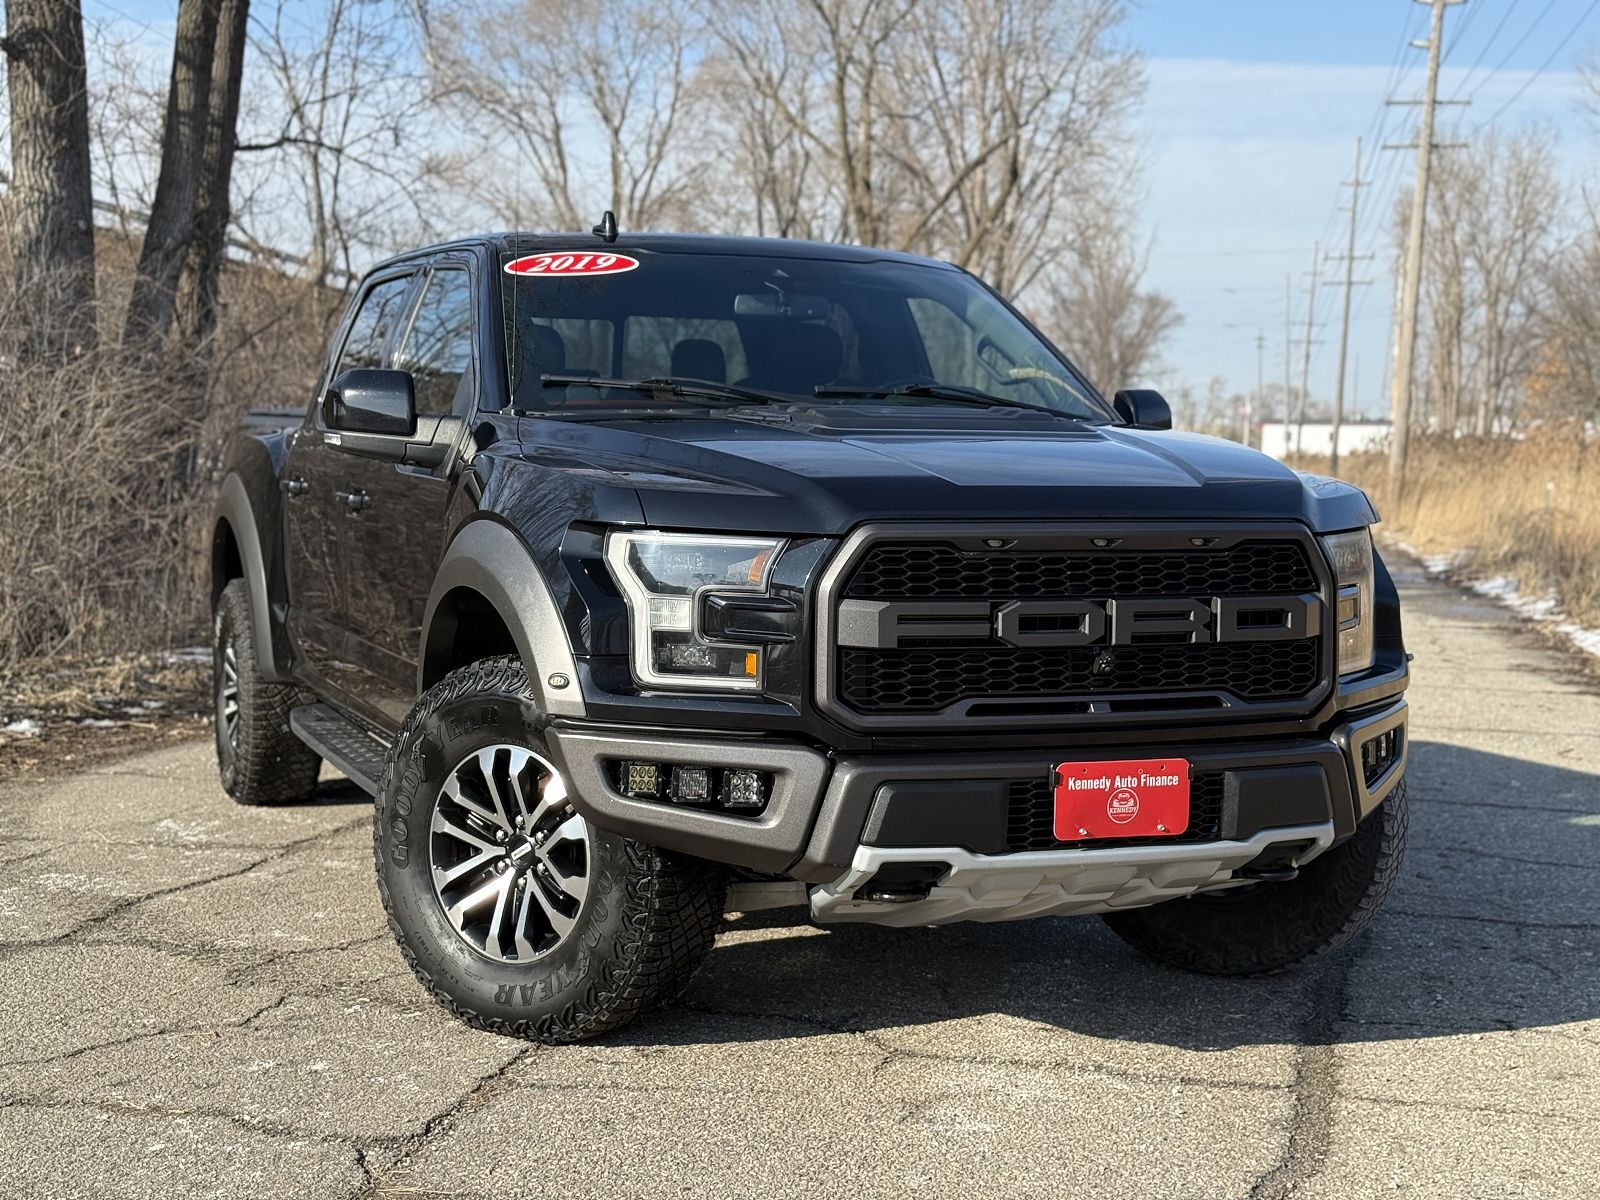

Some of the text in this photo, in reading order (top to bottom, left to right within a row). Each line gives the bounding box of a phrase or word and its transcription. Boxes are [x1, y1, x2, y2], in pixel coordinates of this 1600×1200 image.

[525, 255, 617, 273] 2019
[838, 595, 1320, 648] FORD
[1068, 774, 1179, 791] Kennedy Auto Finance
[1109, 806, 1138, 814] KENNEDY
